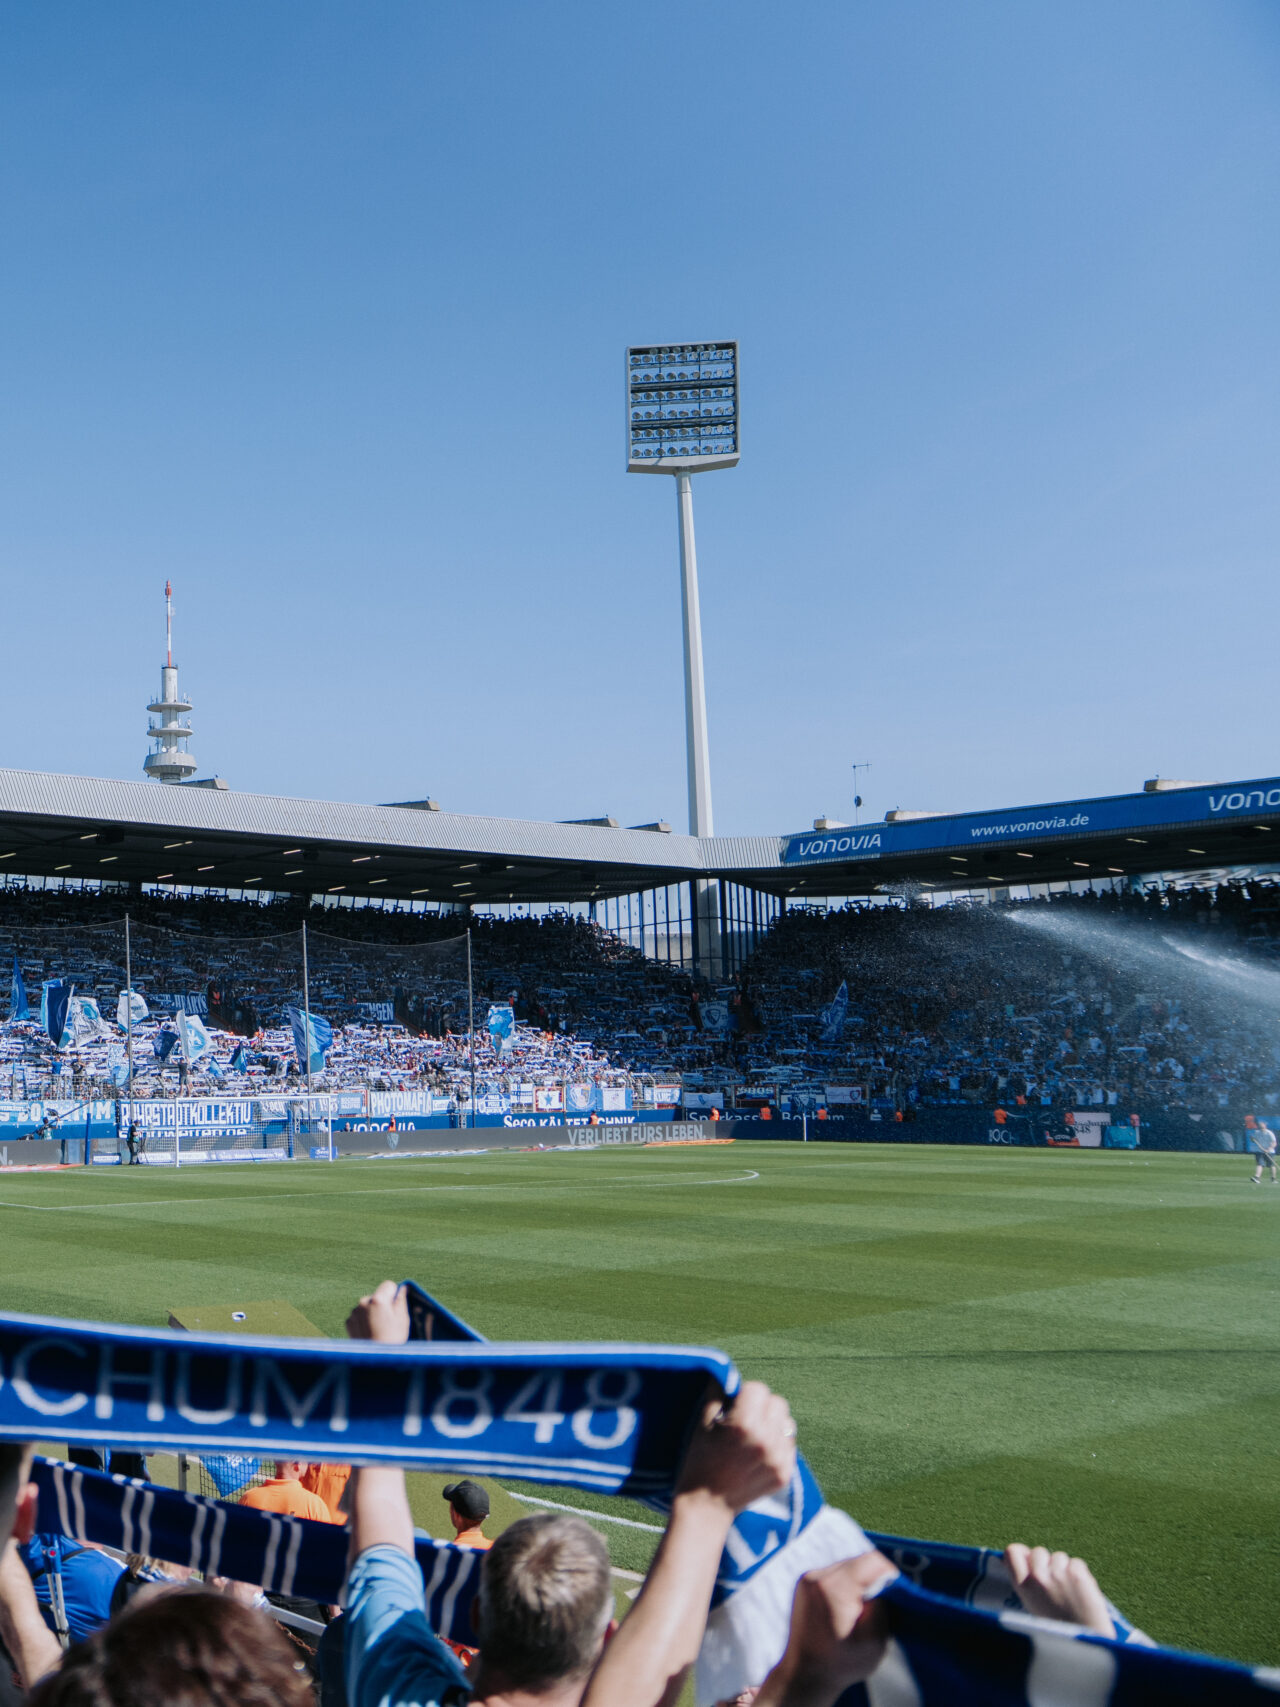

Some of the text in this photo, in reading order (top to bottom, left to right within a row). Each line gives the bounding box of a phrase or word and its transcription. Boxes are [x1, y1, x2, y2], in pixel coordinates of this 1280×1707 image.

[971, 813, 1089, 838] www.vonovia.de
[503, 1115, 535, 1127] Seco
[567, 1122, 707, 1146] VERLIEBT FÜRS LEBEN.
[396, 1364, 642, 1450] 1848
